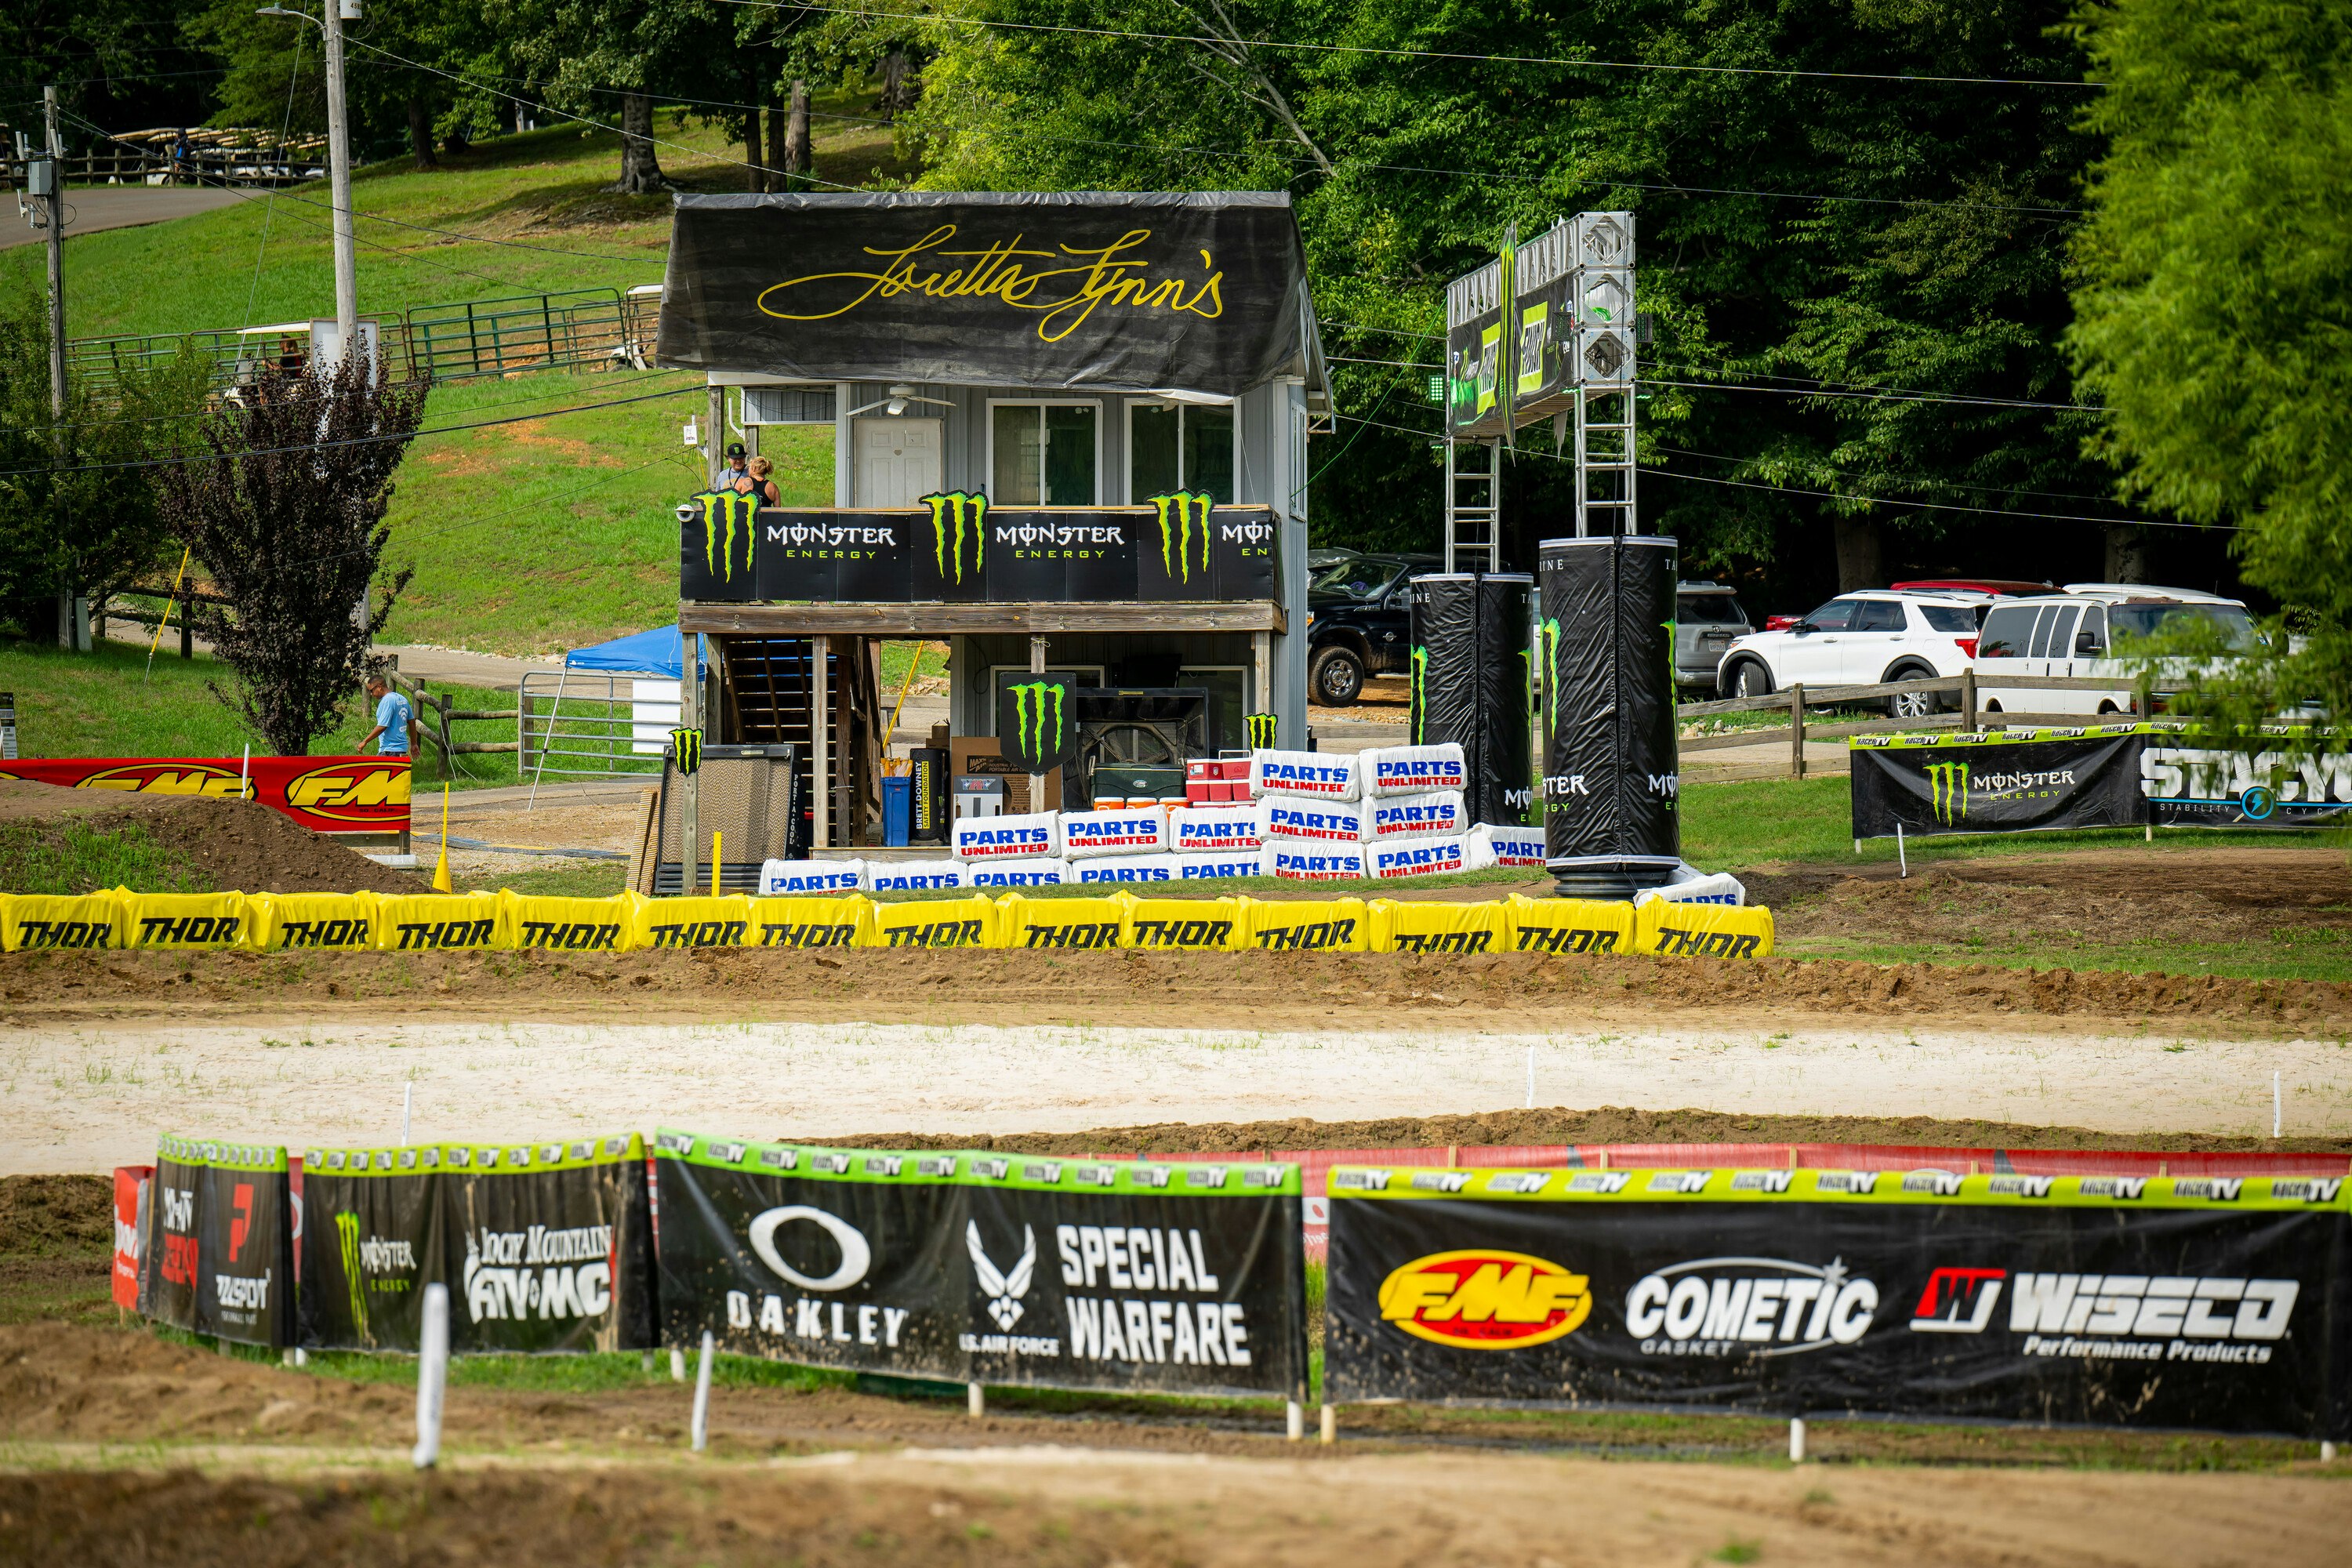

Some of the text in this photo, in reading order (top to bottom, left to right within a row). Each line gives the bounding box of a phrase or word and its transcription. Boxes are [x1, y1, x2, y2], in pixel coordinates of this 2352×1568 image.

[757, 224, 1223, 343] Loretta Lynn's
[767, 523, 896, 546] MONSTER
[996, 523, 1125, 546] MONSTER
[786, 550, 876, 559] ENERGY
[1015, 550, 1105, 559] ENERGY
[1263, 763, 1348, 782] PARTS
[1377, 760, 1461, 777] PARTS
[1377, 776, 1461, 787] UNLIMITED
[1973, 770, 2075, 791] MONSTER
[1990, 789, 2060, 800] ENERGY
[1271, 808, 1359, 831] PARTS
[1376, 804, 1455, 824] PARTS
[2160, 803, 2230, 813] STABILITY
[960, 827, 1048, 846] PARTS
[1068, 819, 1157, 837] PARTS
[1270, 824, 1359, 841] UNLIMITED
[1377, 820, 1454, 835] UNLIMITED
[960, 843, 1048, 856] UNLIMITED
[1069, 835, 1157, 847] UNLIMITED
[1276, 853, 1360, 871] PARTS
[1377, 844, 1461, 868] PARTS
[974, 872, 1061, 887] PARTS
[1081, 867, 1169, 883] PARTS
[1276, 868, 1361, 880] UNLIMITED
[1379, 859, 1461, 879] UNLIMITED
[771, 872, 858, 892] PARTS
[875, 873, 960, 891] PARTS
[18, 920, 112, 949] THOR
[140, 917, 241, 943] THOR
[281, 919, 370, 949] THOR
[396, 920, 495, 949] THOR
[521, 920, 622, 949] THOR
[650, 920, 749, 947] THOR
[760, 923, 857, 949] THOR
[883, 919, 982, 949] THOR
[1024, 923, 1119, 949] THOR
[1133, 920, 1233, 946] THOR
[1256, 918, 1356, 950] THOR
[1393, 930, 1494, 953] THOR
[1517, 926, 1619, 954] THOR
[1656, 926, 1761, 960] THOR
[525, 1224, 613, 1265] MOUNTAIN
[1056, 1225, 1219, 1293] SPECIAL
[1380, 1263, 1590, 1323] FMF
[726, 1290, 909, 1348] OAKLEY
[1625, 1275, 1878, 1344] COMETIC
[1065, 1295, 1252, 1367] WARFARE
[1640, 1339, 1735, 1356] GASKET
[2023, 1334, 2272, 1364] Performance Products
